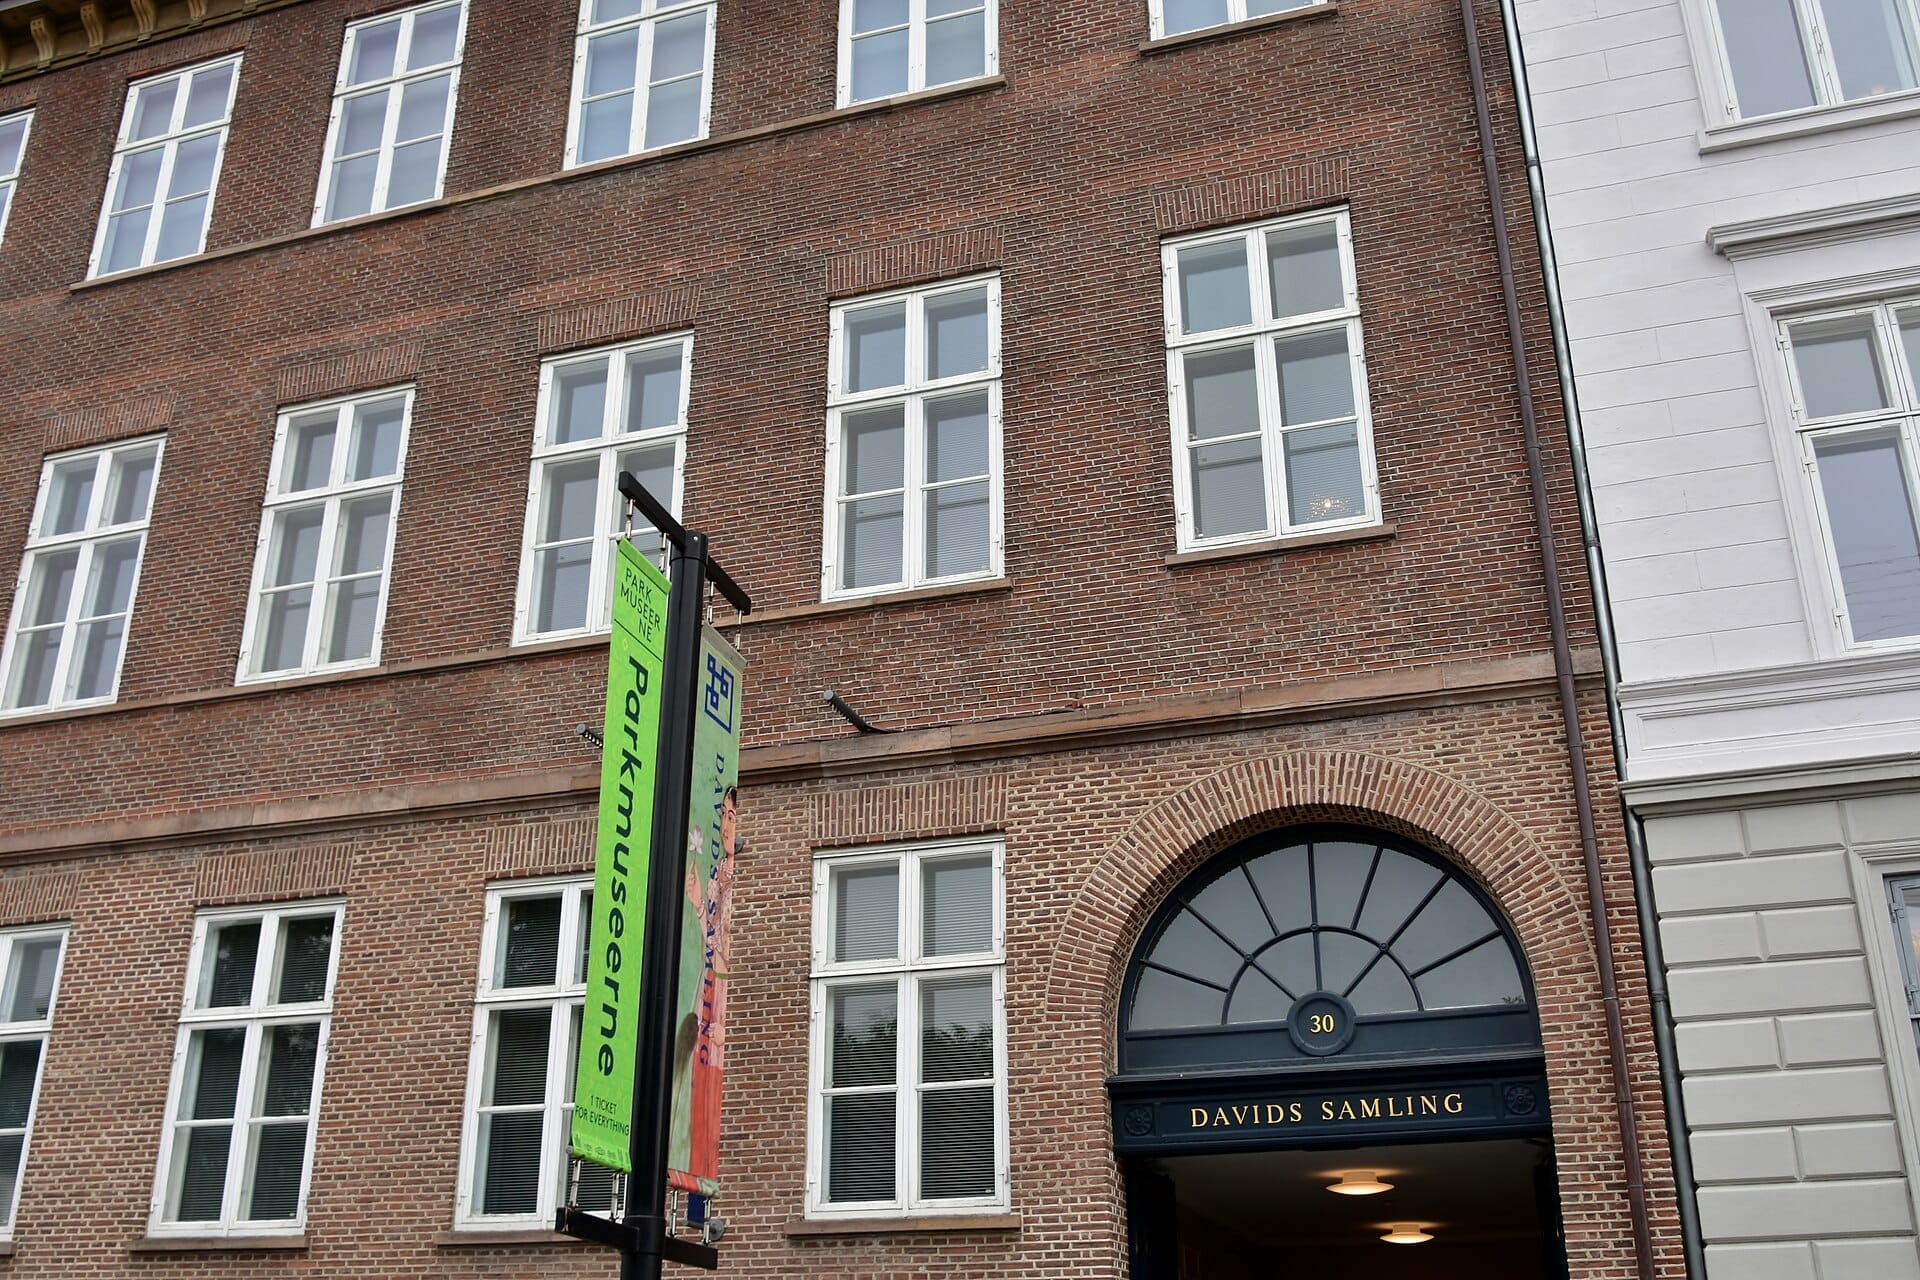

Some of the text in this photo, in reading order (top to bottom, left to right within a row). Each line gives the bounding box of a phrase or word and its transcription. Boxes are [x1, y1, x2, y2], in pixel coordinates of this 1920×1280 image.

[626, 568, 652, 603] PARK
[621, 582, 660, 632] MUSEER
[639, 619, 652, 643] NE
[598, 655, 649, 1077] Parkmuseerne
[700, 752, 724, 1065] DAVIDS SAMLING
[1309, 1014, 1335, 1034] 30
[575, 1105, 630, 1136] FOR EVERYTHING
[590, 1095, 617, 1115] 1 TICKET
[1190, 1093, 1465, 1128] DAVIDS SAMLING
